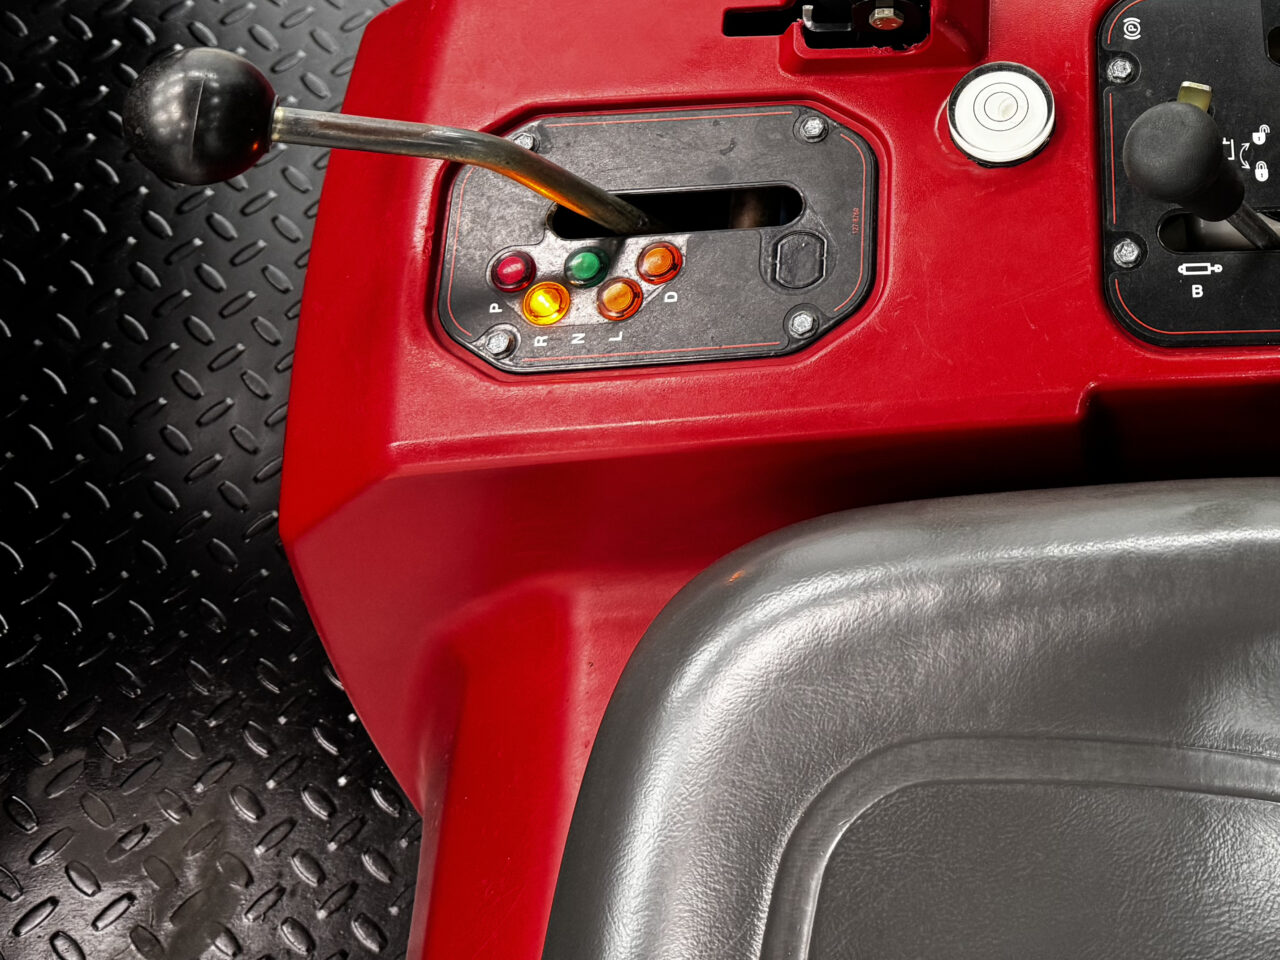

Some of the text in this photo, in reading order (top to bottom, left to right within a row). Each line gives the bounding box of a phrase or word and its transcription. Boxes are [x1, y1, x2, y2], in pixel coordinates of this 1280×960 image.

[1192, 285, 1203, 298] B
[490, 292, 678, 347] P R N L D
